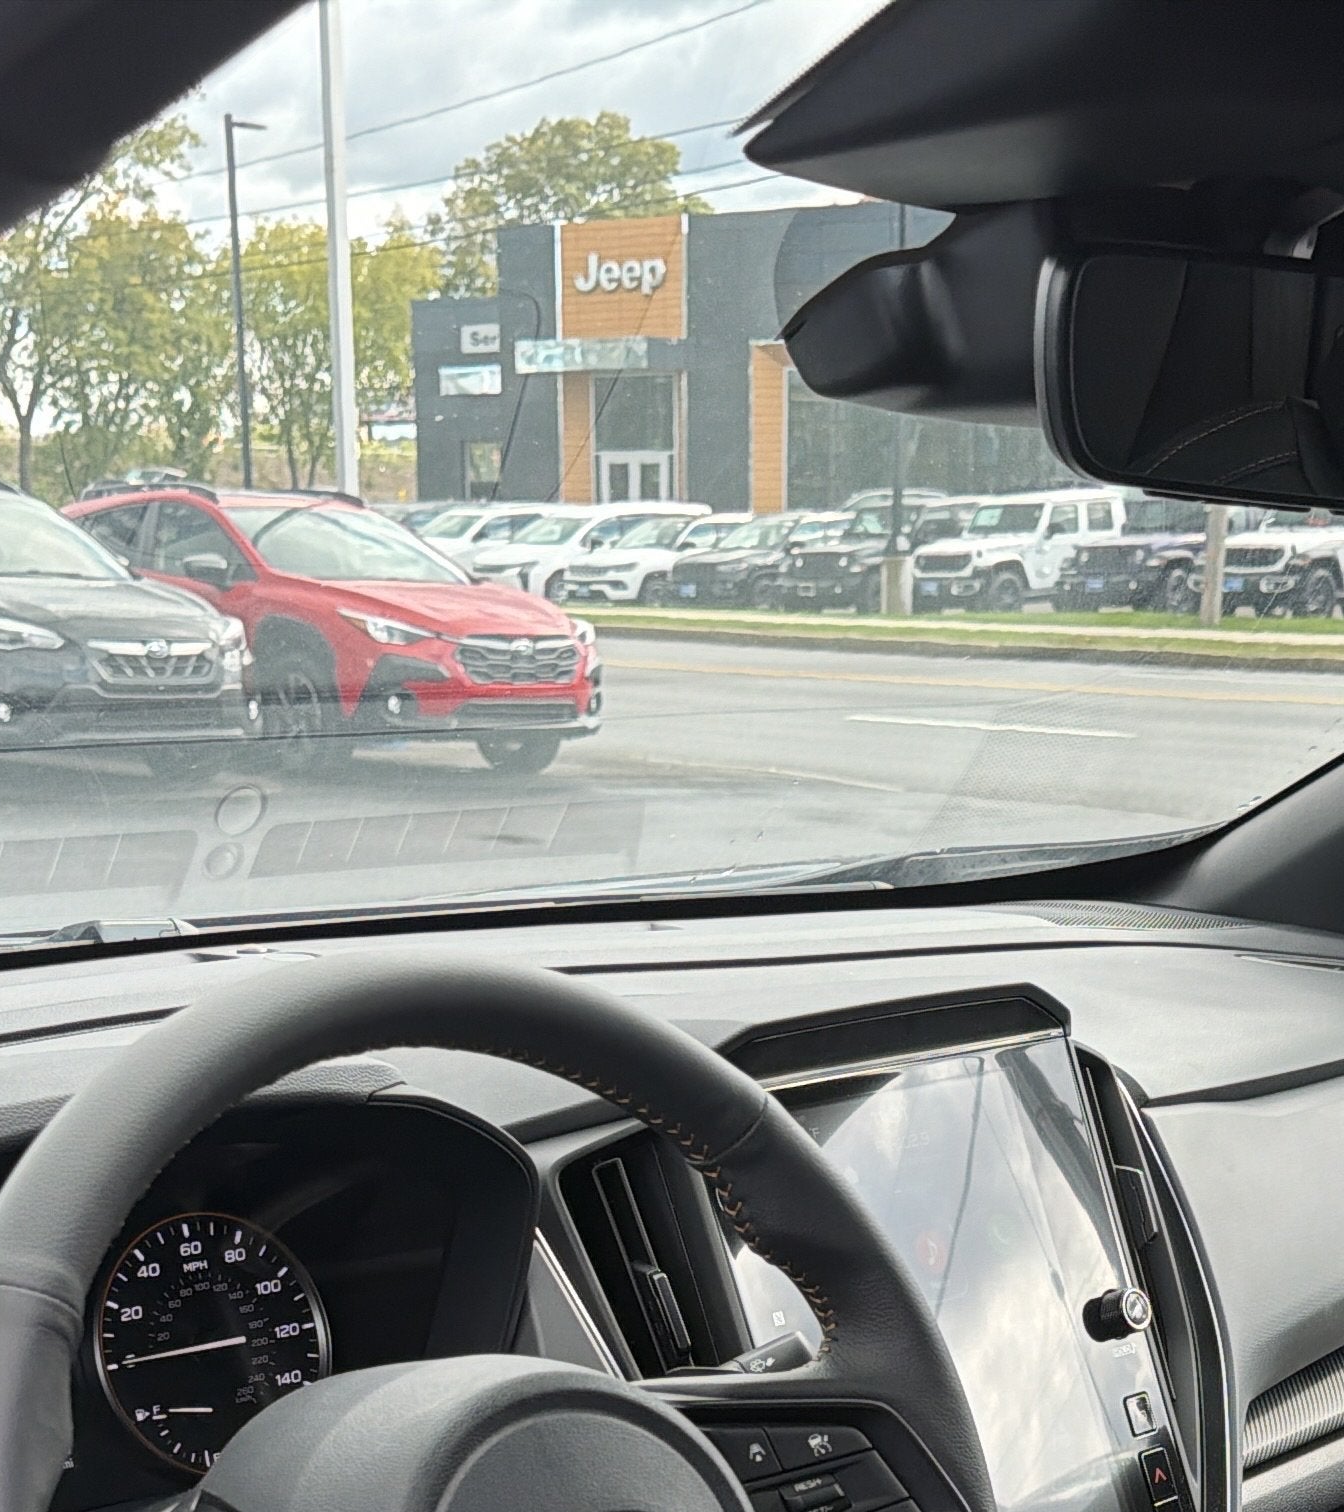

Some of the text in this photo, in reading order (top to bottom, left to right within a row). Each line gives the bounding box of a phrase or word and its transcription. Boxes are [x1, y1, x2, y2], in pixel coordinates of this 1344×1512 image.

[574, 251, 667, 295] Jeep
[179, 1241, 202, 1256] 60
[224, 1248, 246, 1263] 80
[137, 1263, 160, 1277] 40
[183, 1260, 208, 1273] MPH
[255, 1279, 282, 1295] 100
[121, 1306, 143, 1321] 20
[274, 1322, 300, 1339] 120
[276, 1370, 302, 1386] 140
[152, 1405, 161, 1415] F
